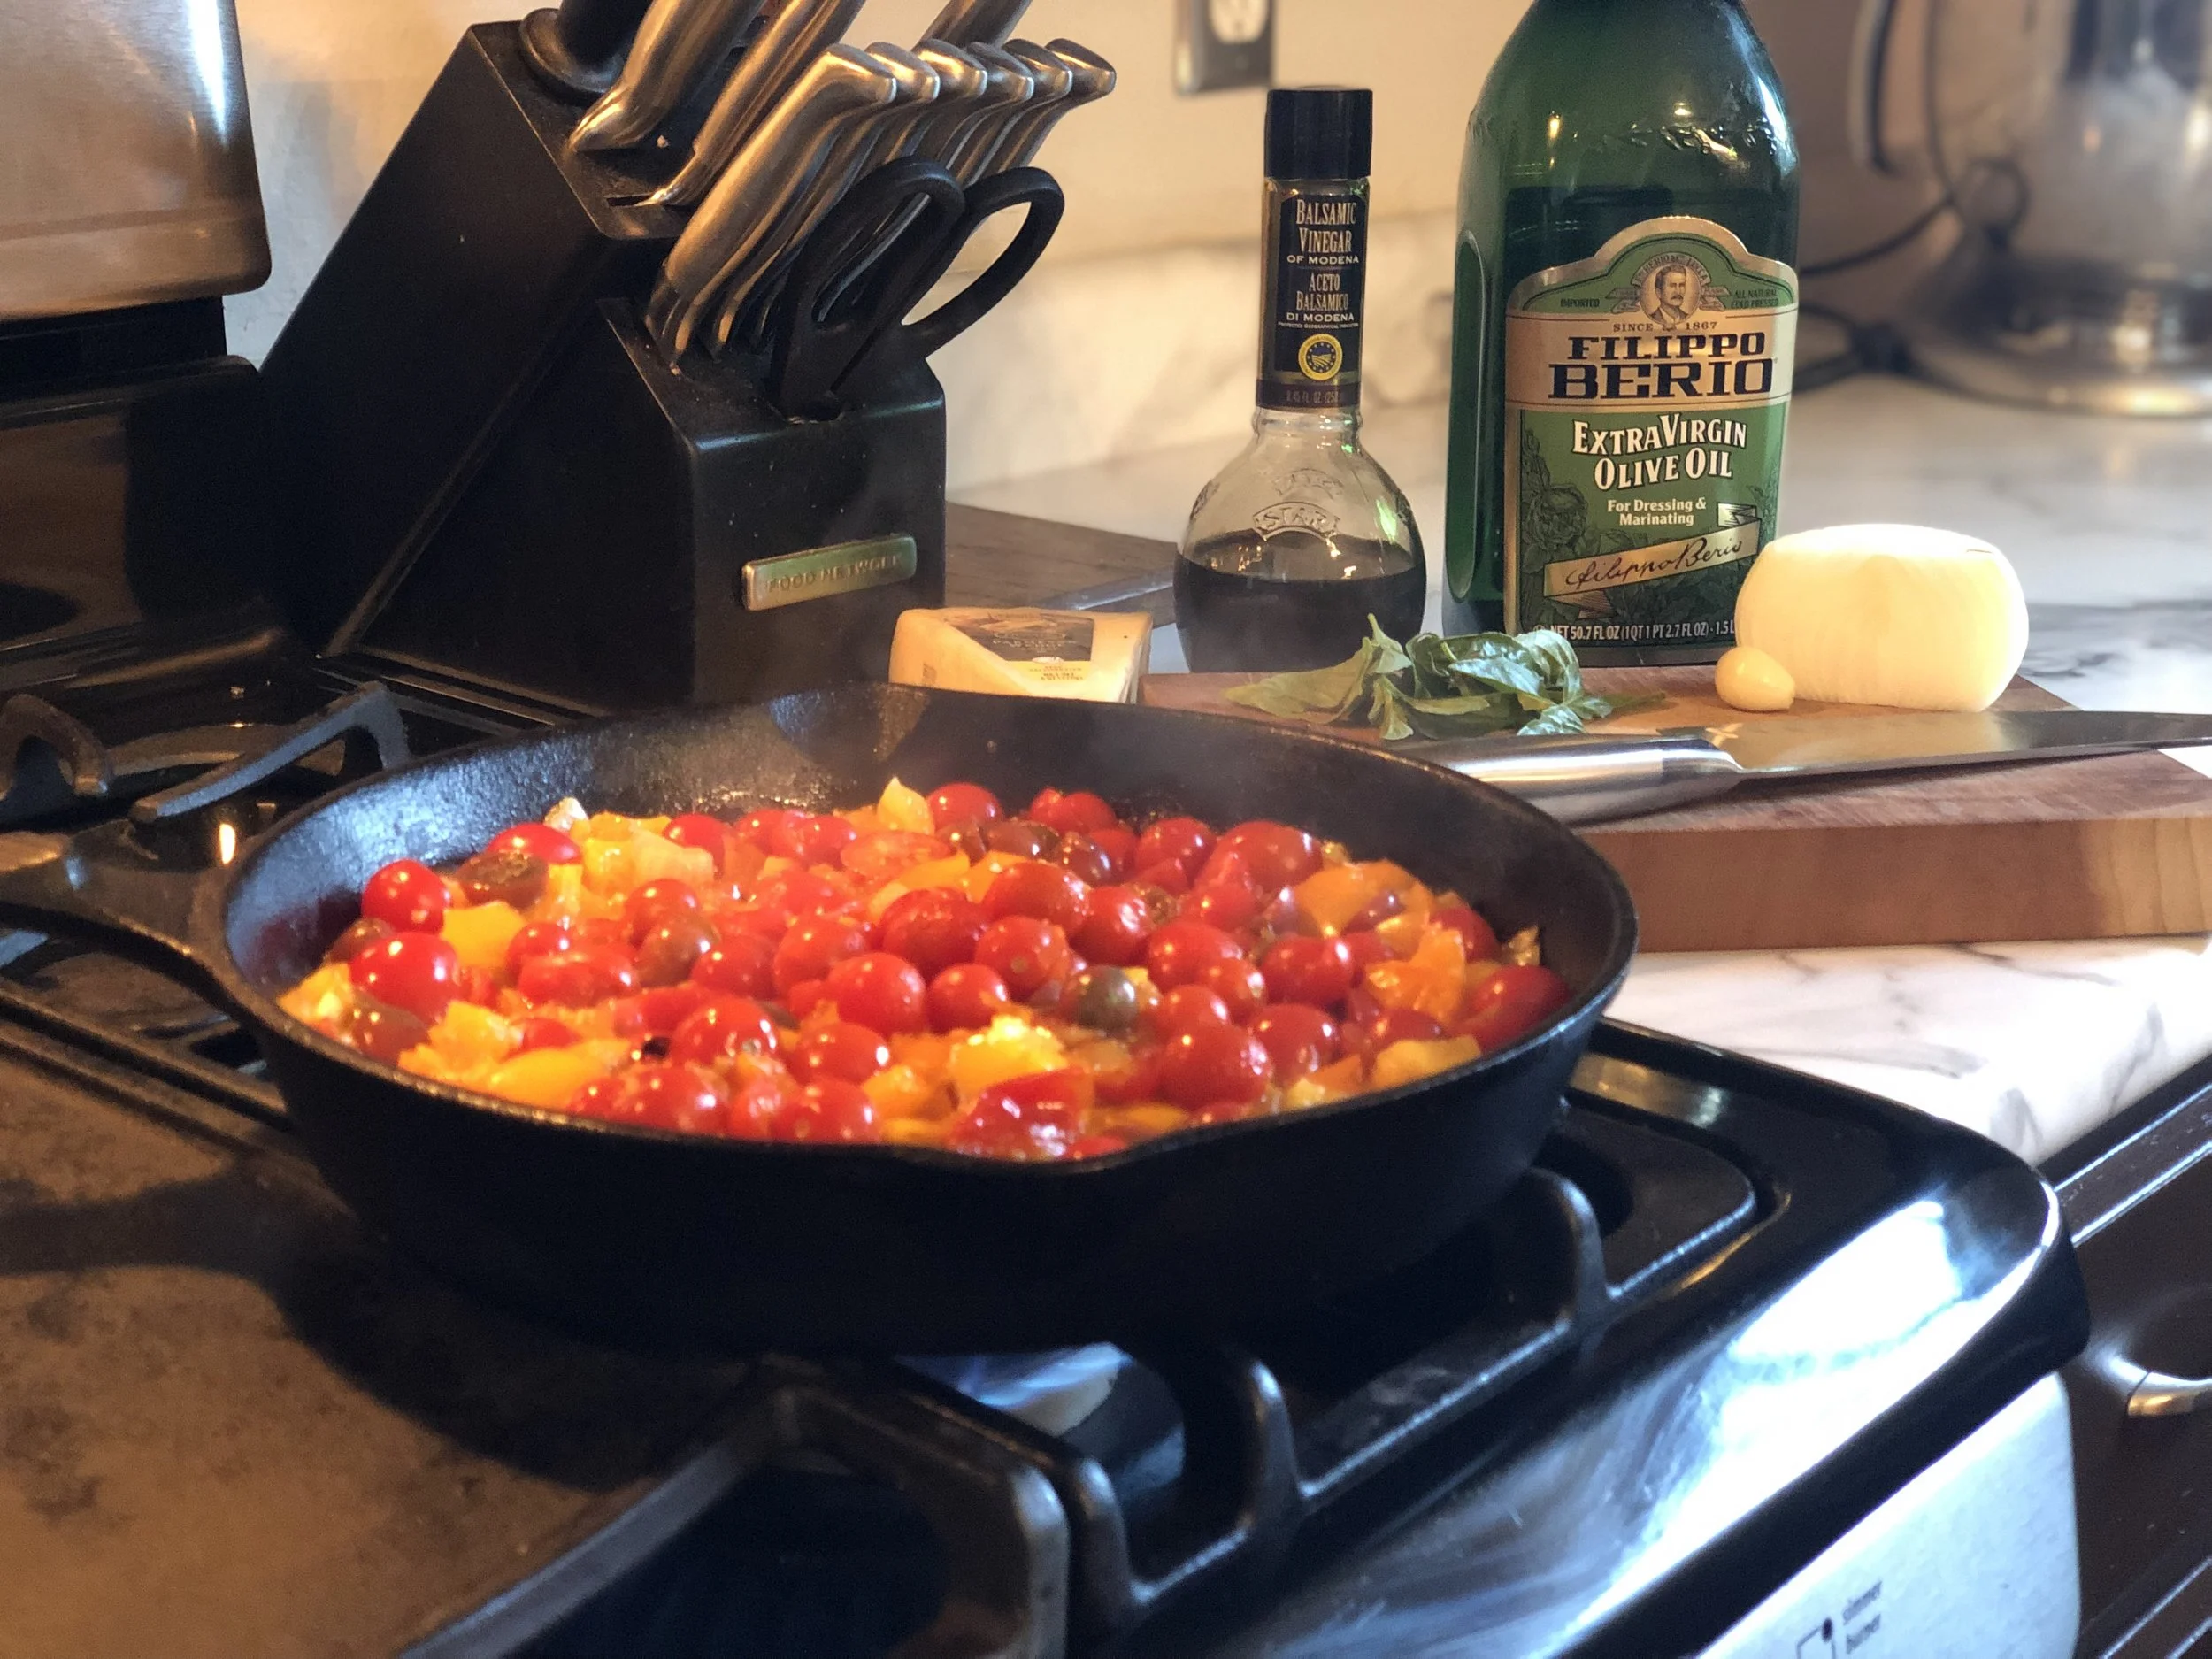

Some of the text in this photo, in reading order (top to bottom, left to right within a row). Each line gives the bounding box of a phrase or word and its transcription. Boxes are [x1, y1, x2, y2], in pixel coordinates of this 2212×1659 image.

[1296, 199, 1357, 226] BALSAMIC
[1298, 227, 1352, 254] VINEGAR
[1286, 255, 1360, 265] OF MODENA
[1309, 272, 1340, 292] ACETO
[1295, 290, 1349, 311] BALSAMICO
[1286, 312, 1355, 322] DI MODENA
[1613, 321, 1717, 332] SINCE 1867
[1567, 332, 1766, 360] FILIPPO
[1548, 358, 1773, 399] BERIO
[1594, 447, 1732, 491] OLIVE OIL
[1607, 496, 1707, 513] For Dressing &
[1619, 512, 1694, 526] Marinating
[1571, 626, 1592, 640] 50.7
[1594, 625, 1605, 640] FL
[1606, 625, 1620, 640] OZ
[1652, 624, 1665, 639] PT
[1665, 624, 1680, 638] 2.7
[1681, 623, 1693, 637] FL
[1694, 622, 1709, 638] OZ)
[1716, 620, 1729, 634] 1.5
